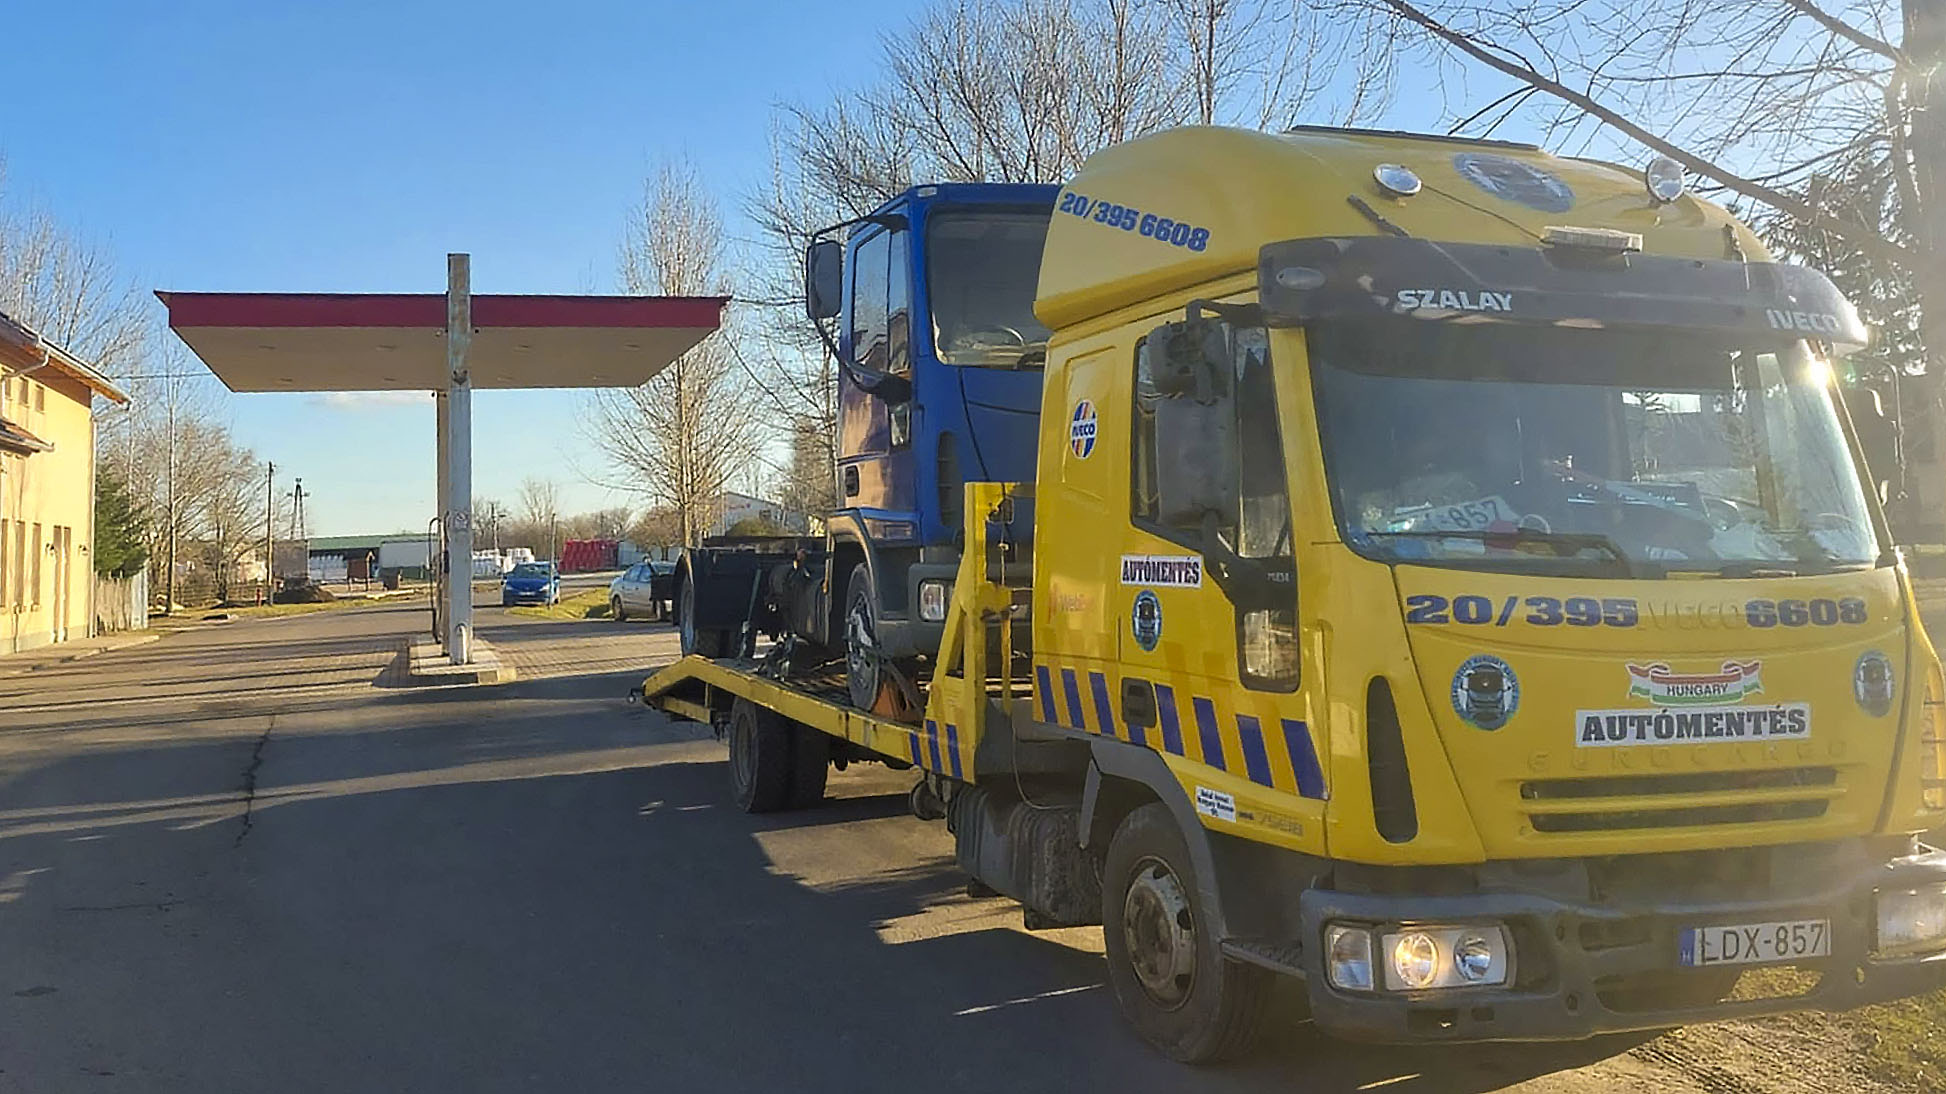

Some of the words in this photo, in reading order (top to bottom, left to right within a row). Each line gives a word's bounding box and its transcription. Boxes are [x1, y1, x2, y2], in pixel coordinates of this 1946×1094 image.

[1059, 192, 1140, 232] 20/395
[1139, 213, 1210, 252] 6608
[1397, 289, 1513, 312] SZALAY
[1765, 308, 1840, 331] IVECO
[1122, 557, 1200, 584] AUTÓMENTÉS
[1406, 595, 1638, 627] 20/395
[1746, 598, 1868, 626] 6608
[1666, 683, 1729, 697] HUNGARY
[1581, 705, 1807, 742] AUTÓMENTÉS
[1701, 923, 1825, 962] LDX-857
